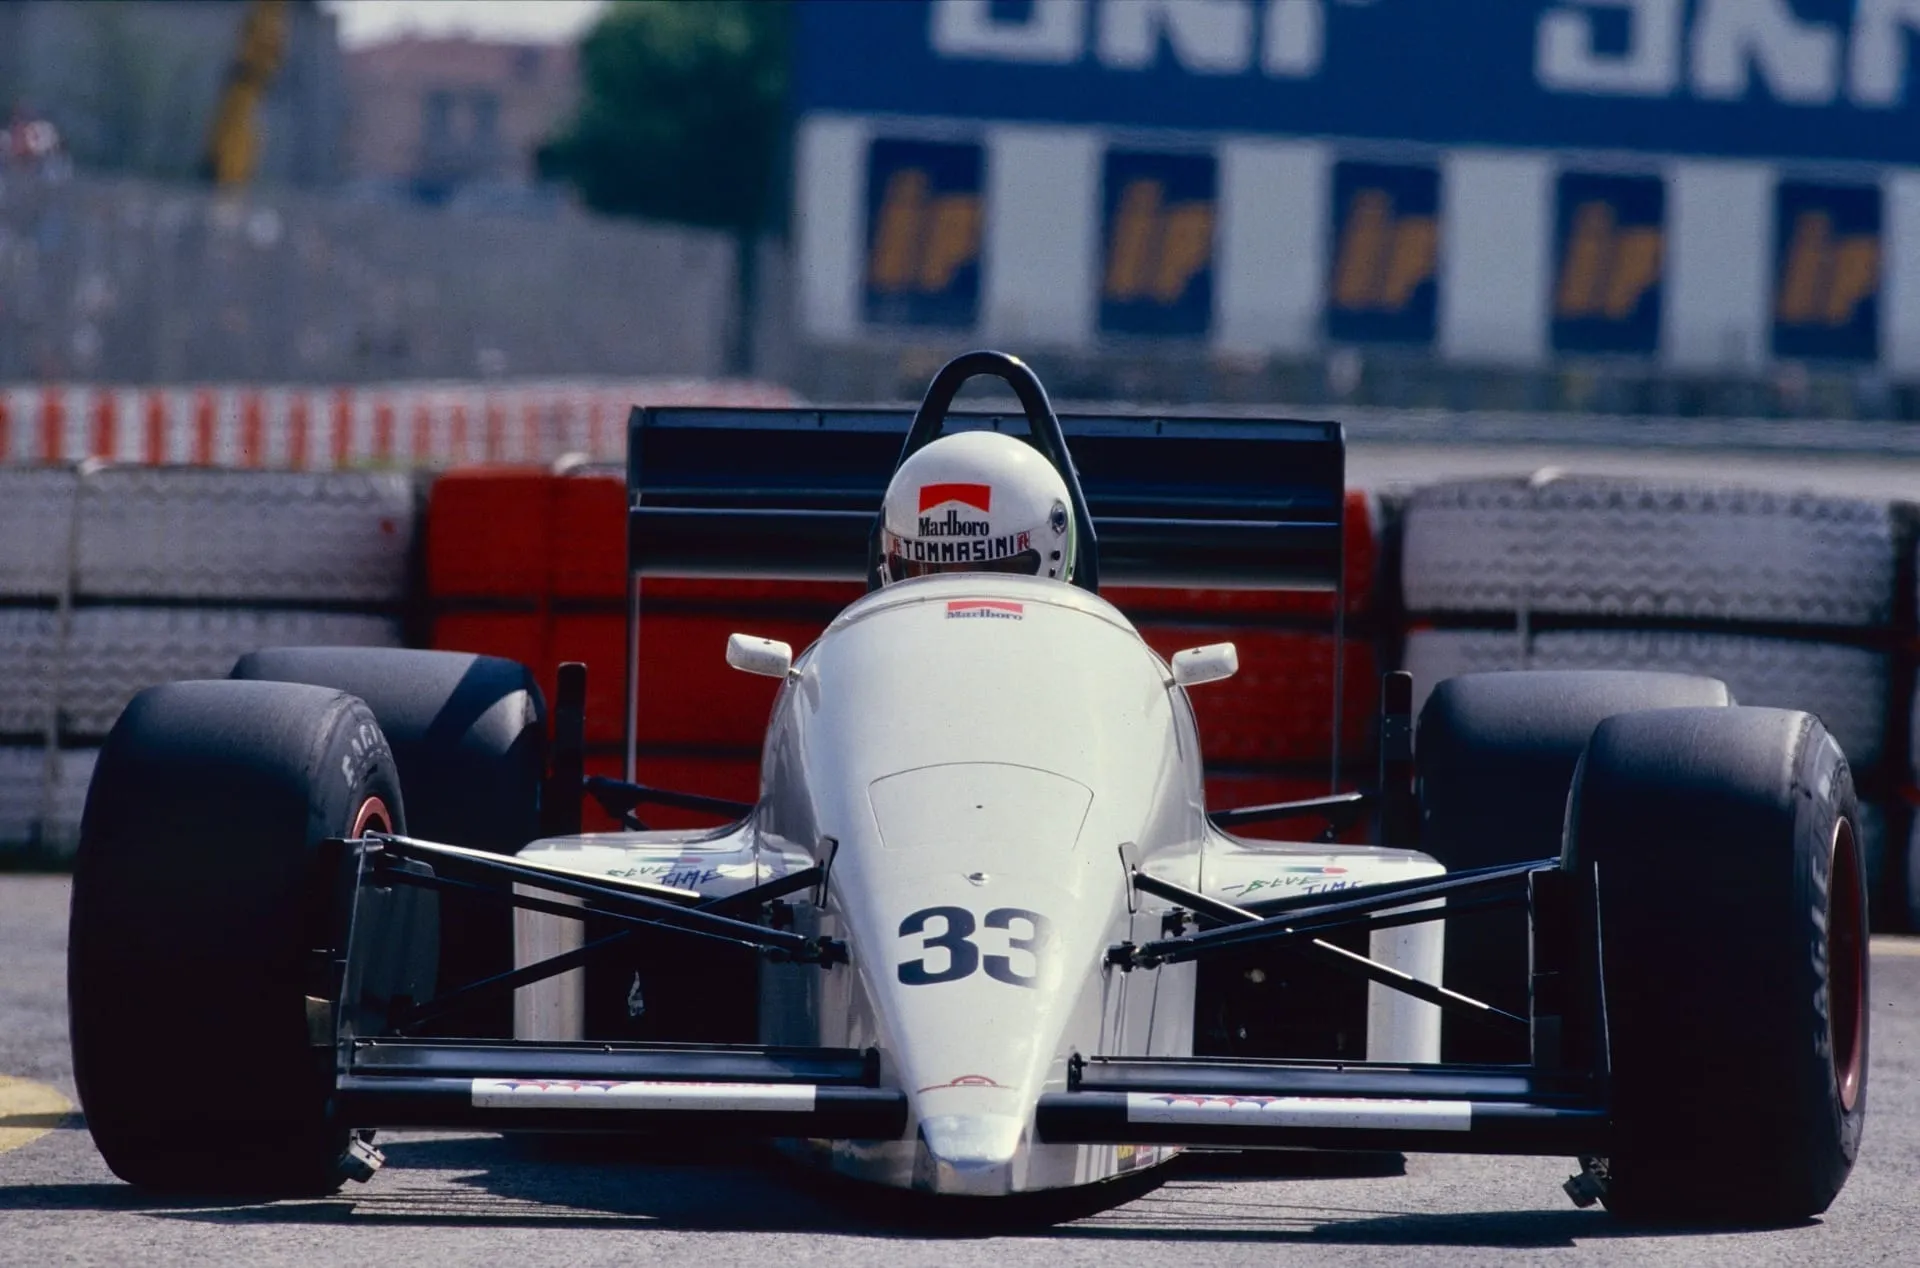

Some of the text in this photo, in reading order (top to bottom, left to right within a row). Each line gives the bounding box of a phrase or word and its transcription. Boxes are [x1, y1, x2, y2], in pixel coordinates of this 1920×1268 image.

[918, 510, 990, 537] Marlboro
[903, 535, 1014, 563] TOMMASINI
[898, 905, 1052, 990] 33
